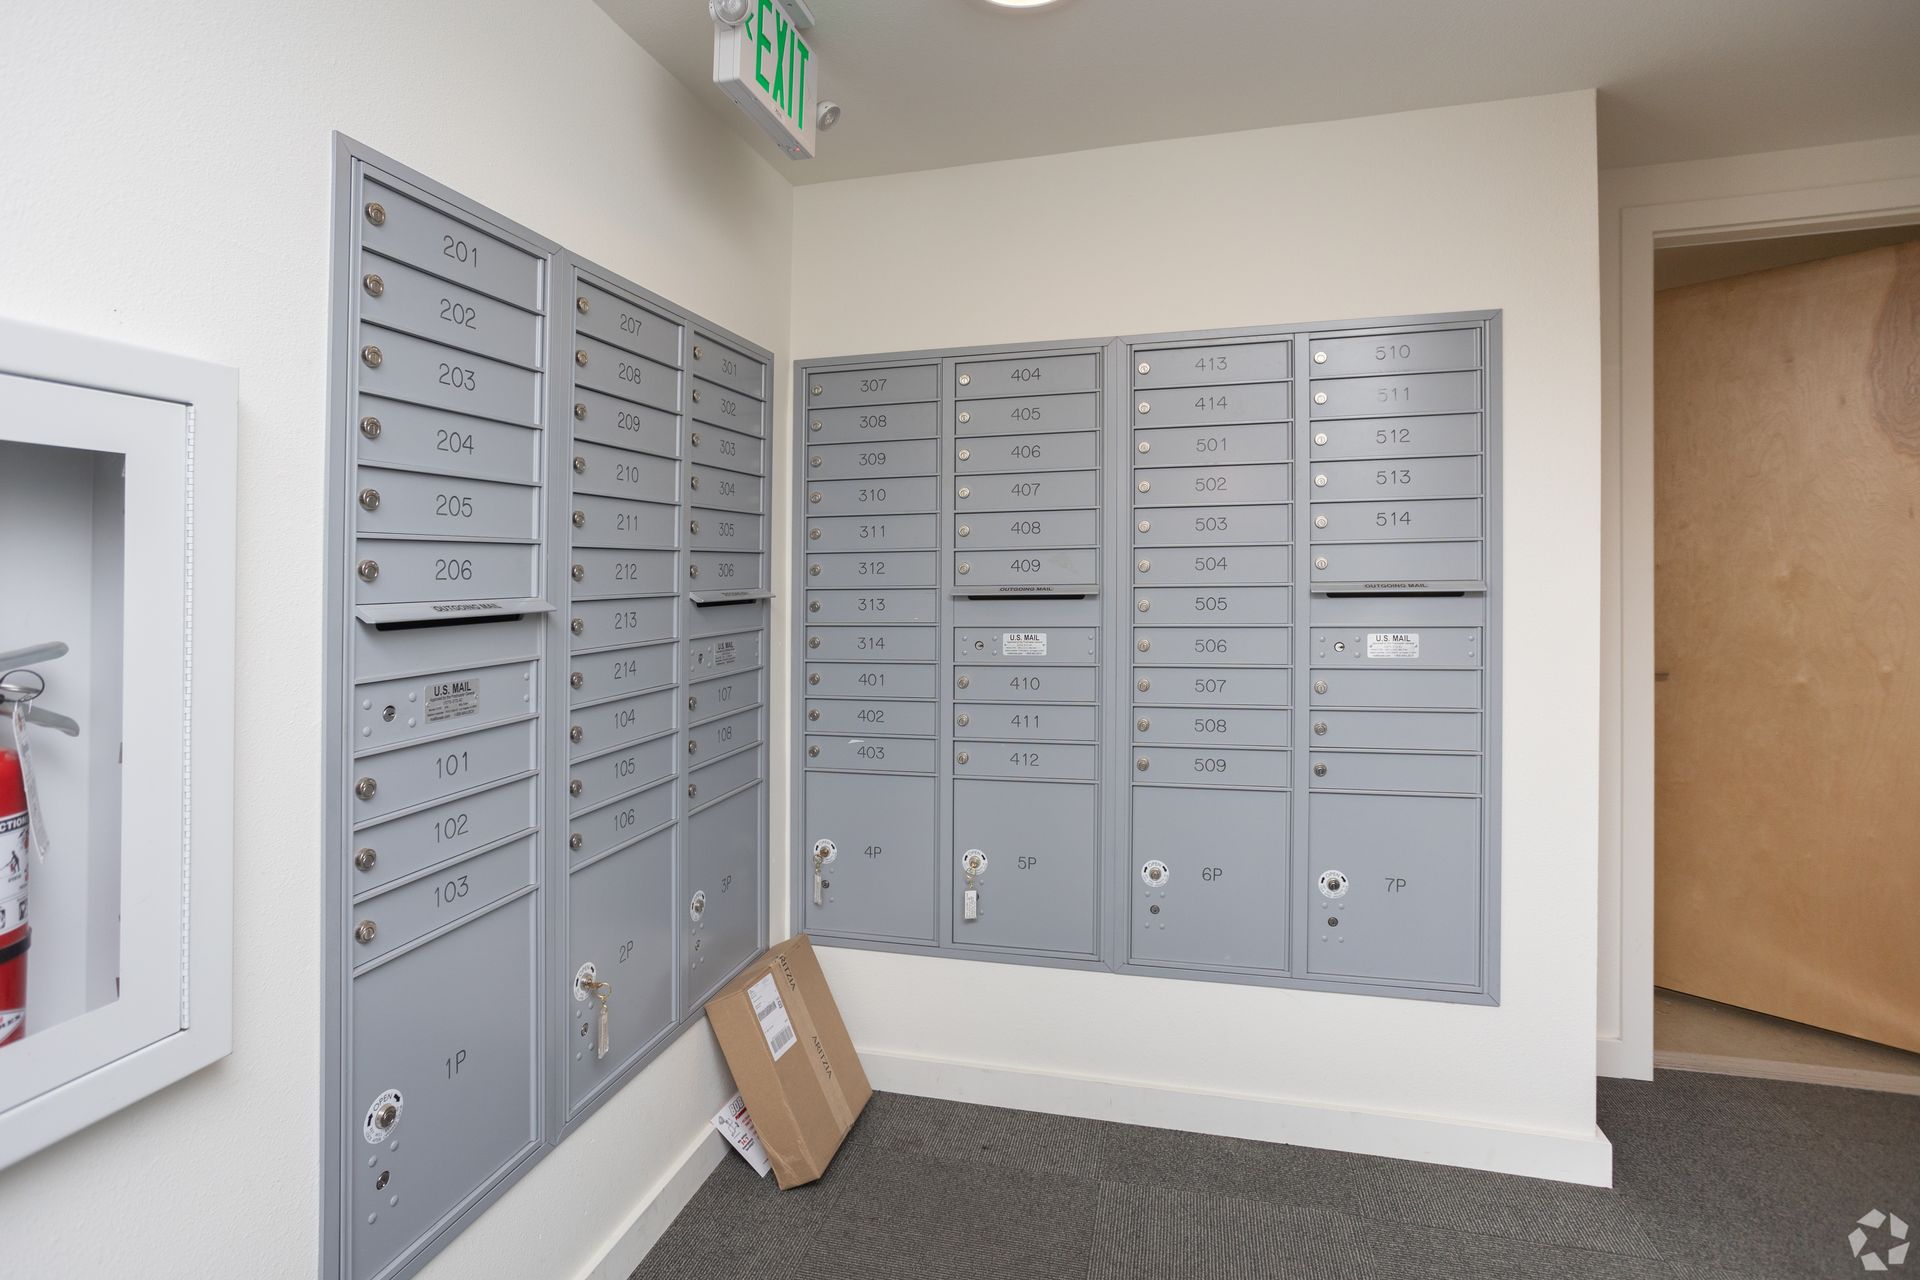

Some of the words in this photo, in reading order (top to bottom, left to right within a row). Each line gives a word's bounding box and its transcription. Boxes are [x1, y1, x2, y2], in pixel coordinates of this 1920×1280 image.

[756, 0, 809, 129] EXIT
[442, 234, 479, 268] 201
[439, 298, 478, 331] 202
[619, 313, 644, 338] 207
[1375, 344, 1411, 361] 510
[721, 357, 738, 378] 301
[1194, 356, 1228, 372] 413
[438, 362, 477, 392] 203
[618, 361, 643, 386] 208
[1010, 367, 1042, 382] 404
[860, 378, 888, 393] 307
[1378, 386, 1409, 403] 511
[720, 398, 737, 417] 302
[1194, 395, 1229, 411] 414
[616, 411, 642, 433] 209
[859, 414, 887, 429] 308
[1010, 407, 1041, 421] 405
[436, 429, 475, 456] 204
[1375, 428, 1411, 445] 512
[719, 439, 736, 457] 303
[1010, 444, 1041, 459] 406
[1195, 437, 1227, 453] 501
[858, 452, 887, 466] 309
[616, 463, 640, 484] 210
[1375, 469, 1412, 486] 513
[719, 480, 736, 497] 304
[1010, 482, 1041, 497] 407
[1194, 476, 1228, 492] 502
[858, 488, 887, 502] 310
[435, 494, 474, 519] 205
[616, 513, 638, 532] 211
[1194, 516, 1228, 532] 503
[1375, 511, 1412, 527] 514
[718, 522, 735, 537] 305
[859, 524, 885, 539] 311
[1010, 521, 1042, 535] 408
[435, 558, 473, 581] 206
[615, 562, 638, 581] 212
[717, 562, 735, 578] 306
[858, 561, 886, 575] 312
[1010, 558, 1041, 573] 409
[1194, 556, 1228, 572] 504
[432, 604, 479, 612] OUTGOING
[480, 603, 502, 611] MAIL
[857, 598, 886, 612] 313
[1194, 596, 1228, 611] 505
[614, 611, 638, 630] 213
[857, 636, 886, 650] 314
[1194, 638, 1228, 653] 506
[1375, 634, 1390, 642] U.S.
[1392, 634, 1411, 642] MAIL
[613, 659, 637, 680] 214
[857, 673, 885, 687] 401
[1009, 676, 1041, 691] 410
[1194, 678, 1227, 694] 507
[434, 685, 450, 697] U.S.
[452, 681, 471, 693] MAIL
[717, 685, 733, 703] 107
[613, 708, 636, 730] 104
[857, 709, 885, 724] 402
[1010, 714, 1039, 729] 411
[1194, 718, 1227, 733] 508
[716, 725, 733, 744] 108
[856, 745, 885, 760] 403
[1009, 752, 1040, 767] 412
[435, 750, 470, 779] 101
[613, 757, 636, 779] 105
[1193, 758, 1227, 773] 509
[612, 807, 636, 832] 106
[434, 812, 469, 844] 102
[863, 845, 882, 859] 4P
[1017, 855, 1037, 870] 5P
[1201, 866, 1223, 882] 6P
[434, 875, 471, 909] 103
[721, 874, 732, 894] 3P
[1384, 877, 1407, 893] 7P
[619, 940, 634, 964] 2P
[445, 1049, 467, 1080] 1P
[373, 1093, 393, 1111] OPEN
